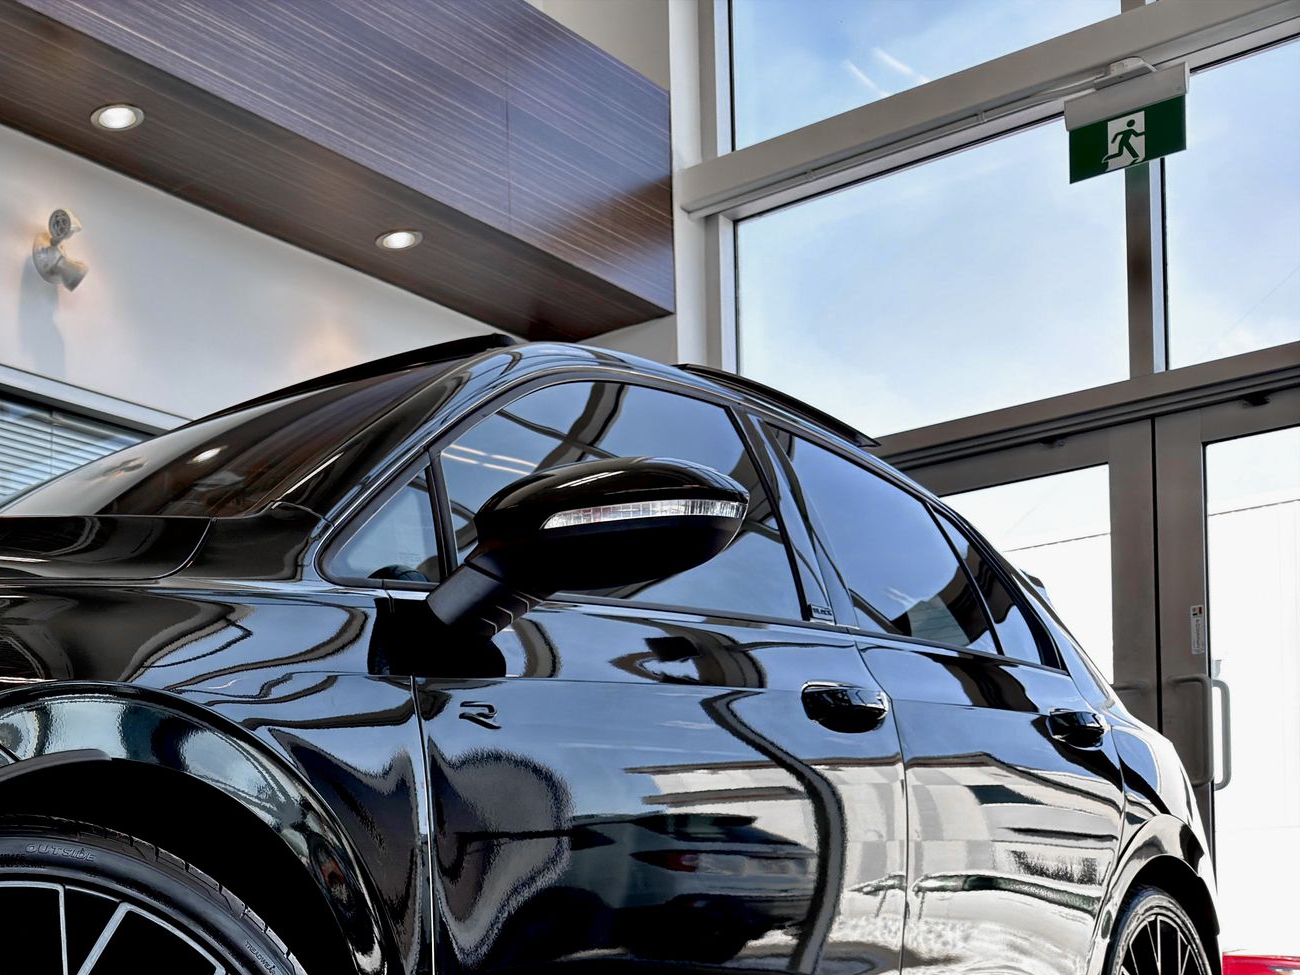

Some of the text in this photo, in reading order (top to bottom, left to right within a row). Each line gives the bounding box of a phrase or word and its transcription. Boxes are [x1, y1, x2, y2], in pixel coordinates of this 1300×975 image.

[458, 700, 502, 730] R
[25, 843, 97, 862] OUTSIDE
[244, 941, 277, 975] TREADWEAR
